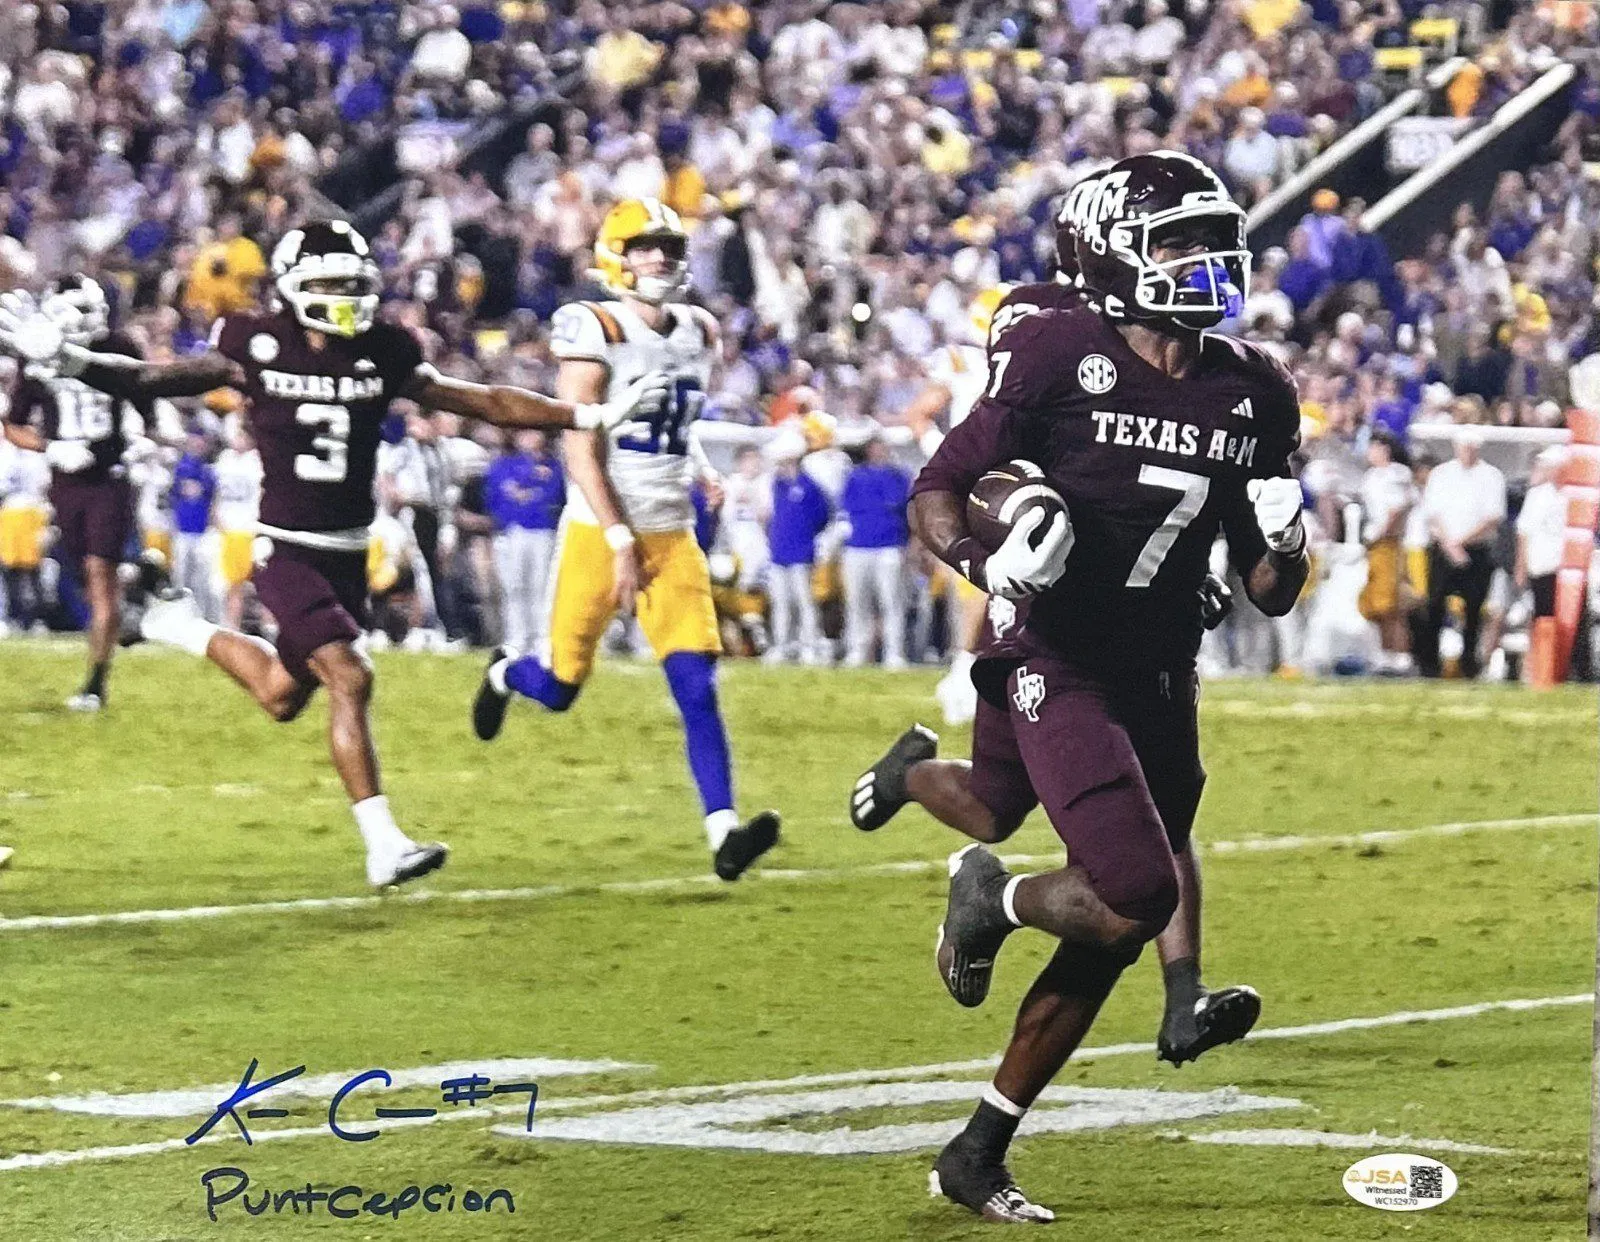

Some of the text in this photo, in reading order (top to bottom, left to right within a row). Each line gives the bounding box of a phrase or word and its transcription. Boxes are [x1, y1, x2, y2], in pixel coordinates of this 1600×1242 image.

[259, 369, 335, 401] TEXAS
[988, 351, 1012, 399] 7
[1080, 357, 1114, 391] SEC
[294, 402, 350, 481] 3
[1091, 410, 1258, 468] TEXAS A&M
[1124, 463, 1211, 588] 7
[1362, 1170, 1408, 1184] JSA
[1365, 1186, 1407, 1195] Witnessed
